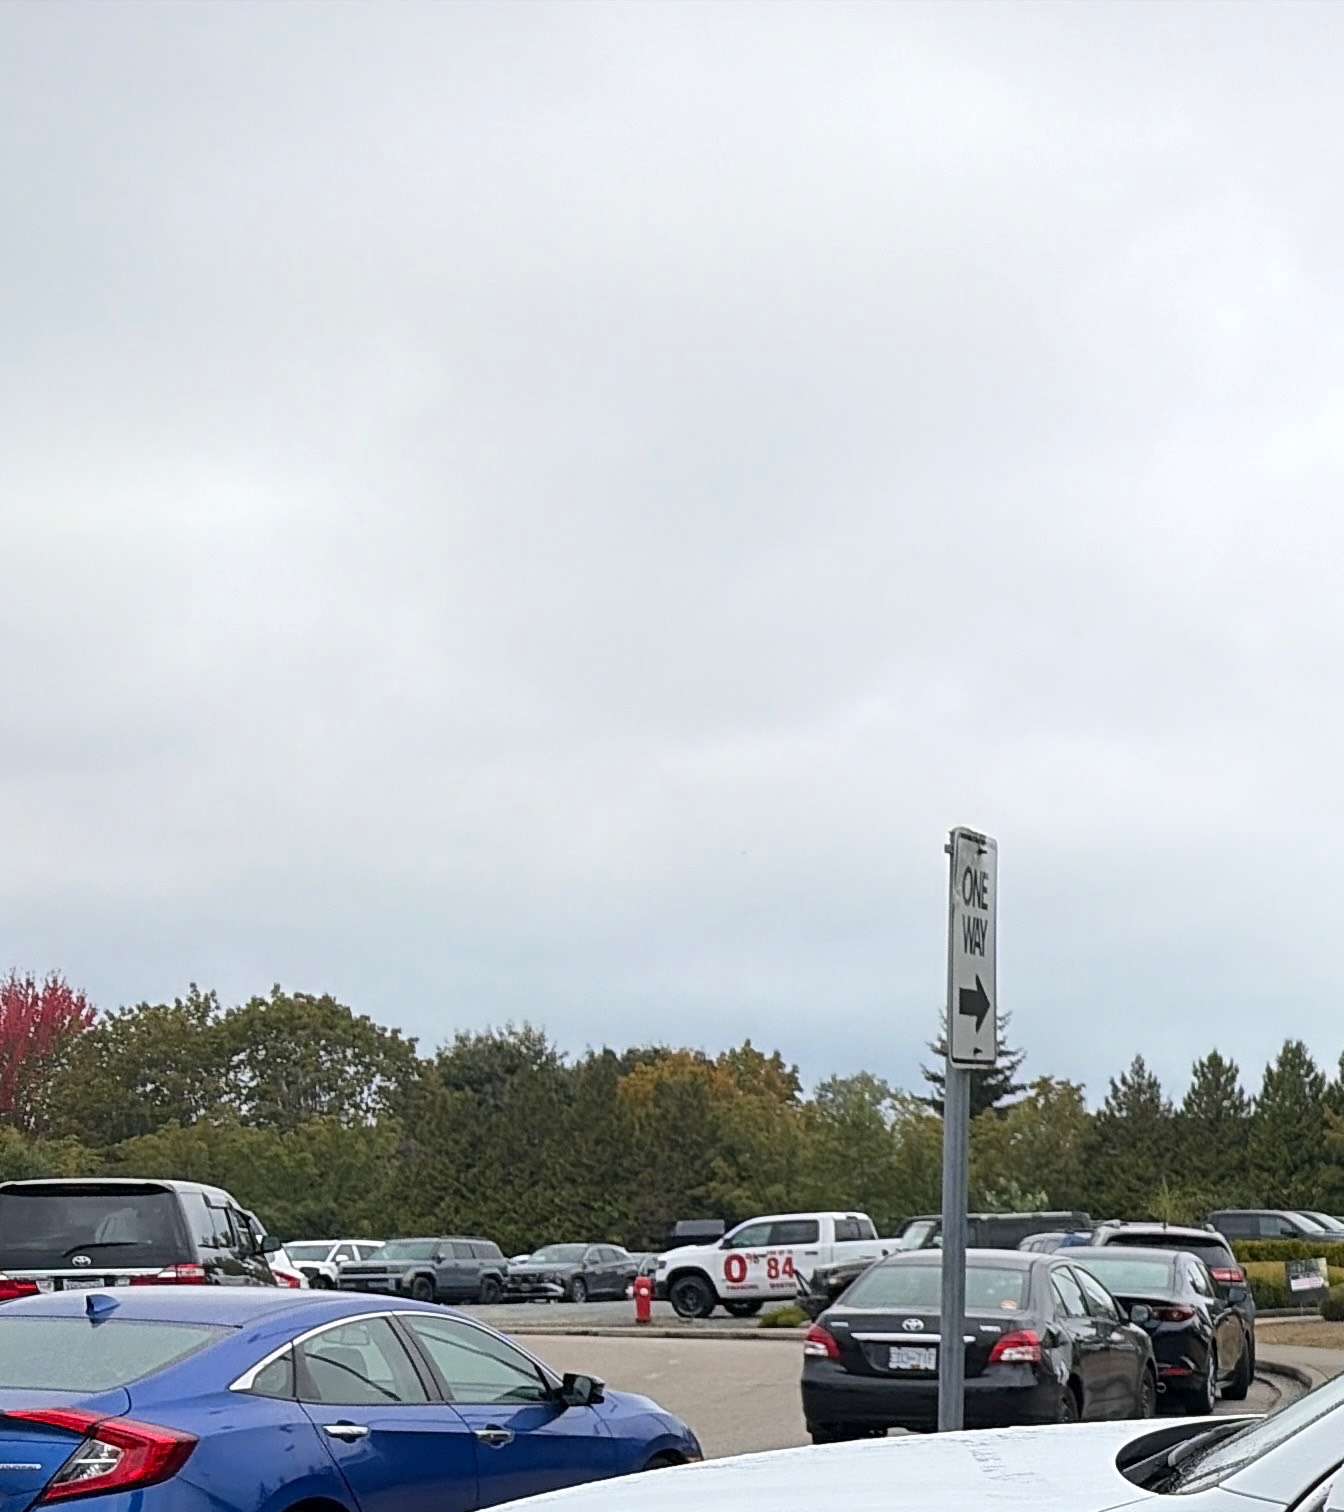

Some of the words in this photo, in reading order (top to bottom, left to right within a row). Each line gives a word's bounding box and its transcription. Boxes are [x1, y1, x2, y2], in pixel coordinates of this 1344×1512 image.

[961, 865, 988, 910] ONE
[961, 913, 988, 957] WAY
[767, 1256, 795, 1279] 84
